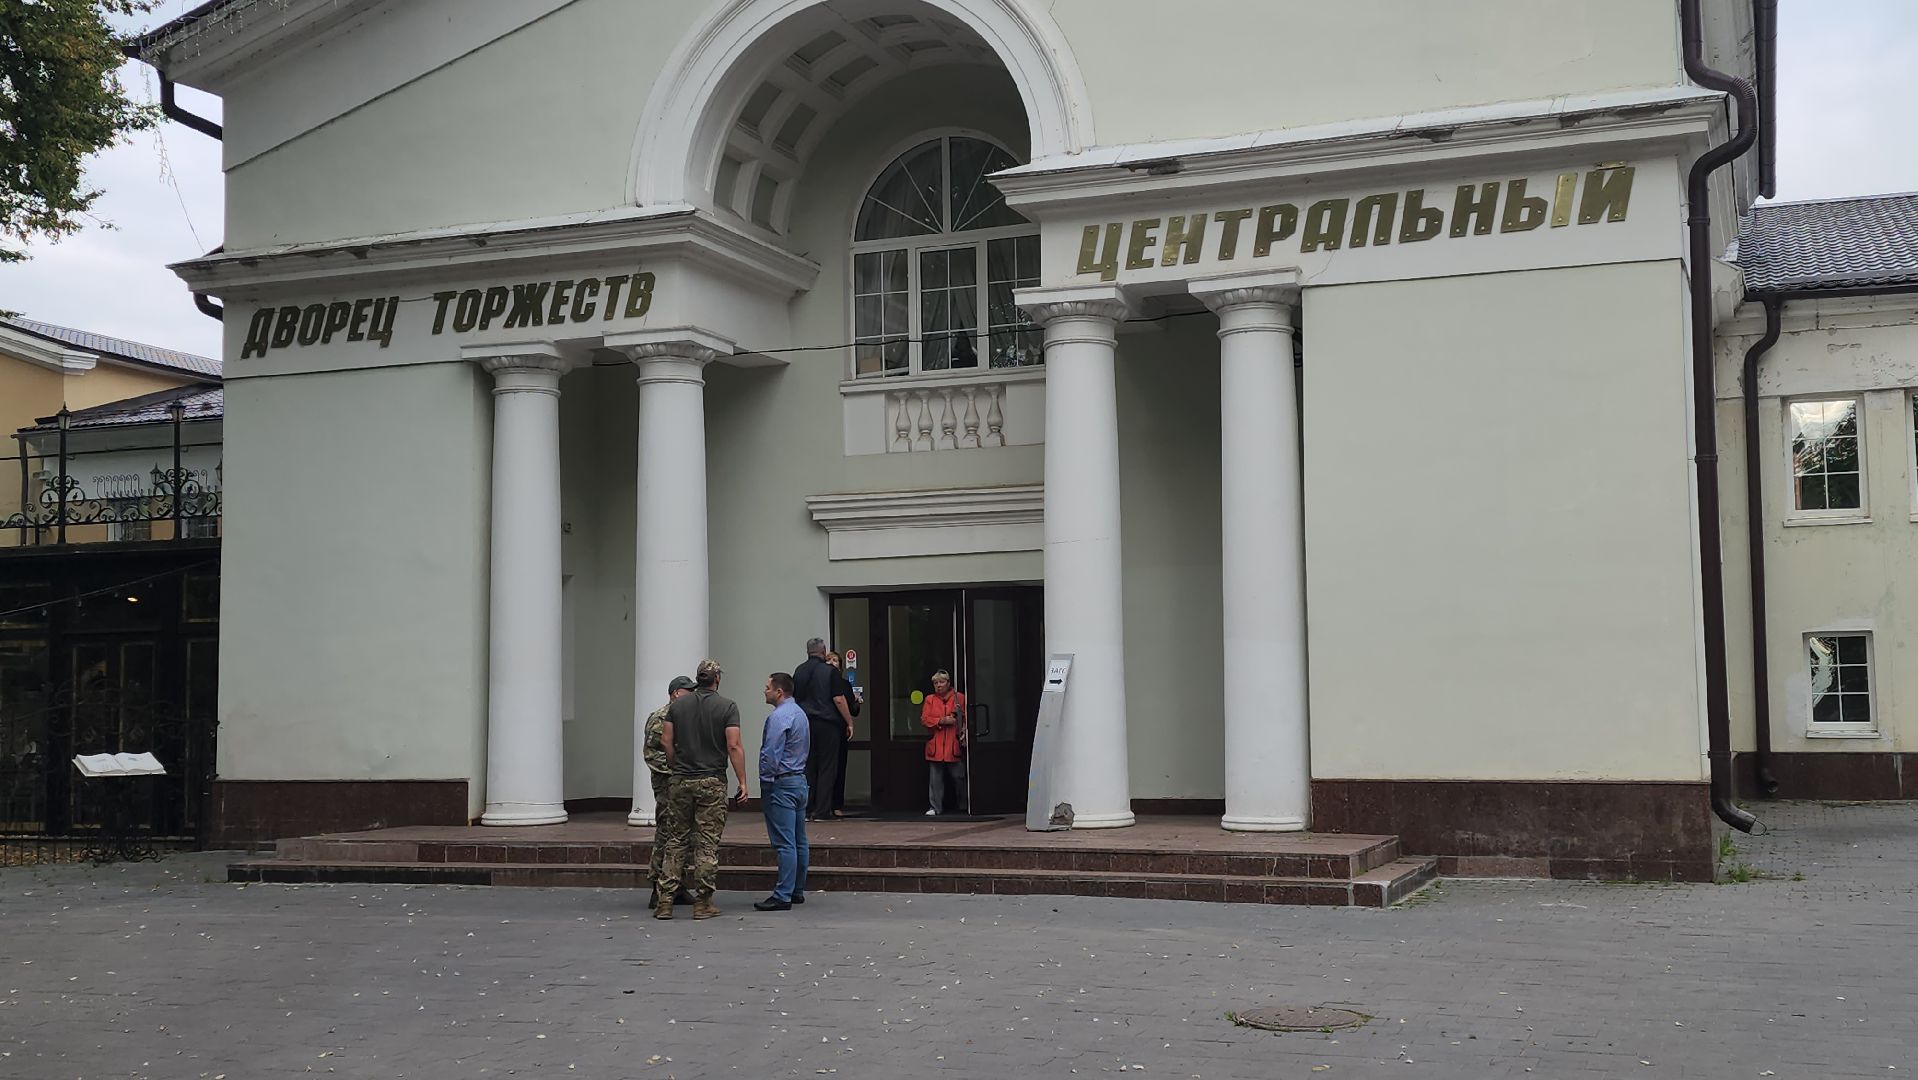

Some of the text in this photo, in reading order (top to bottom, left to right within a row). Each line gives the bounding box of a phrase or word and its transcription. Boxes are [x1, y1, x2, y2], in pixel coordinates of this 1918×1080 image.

[1077, 162, 1635, 280] ЦЕНТРАЛЬНЫЙ
[241, 272, 656, 359] ДВОРЕЦ ТОРЖЕСТВ
